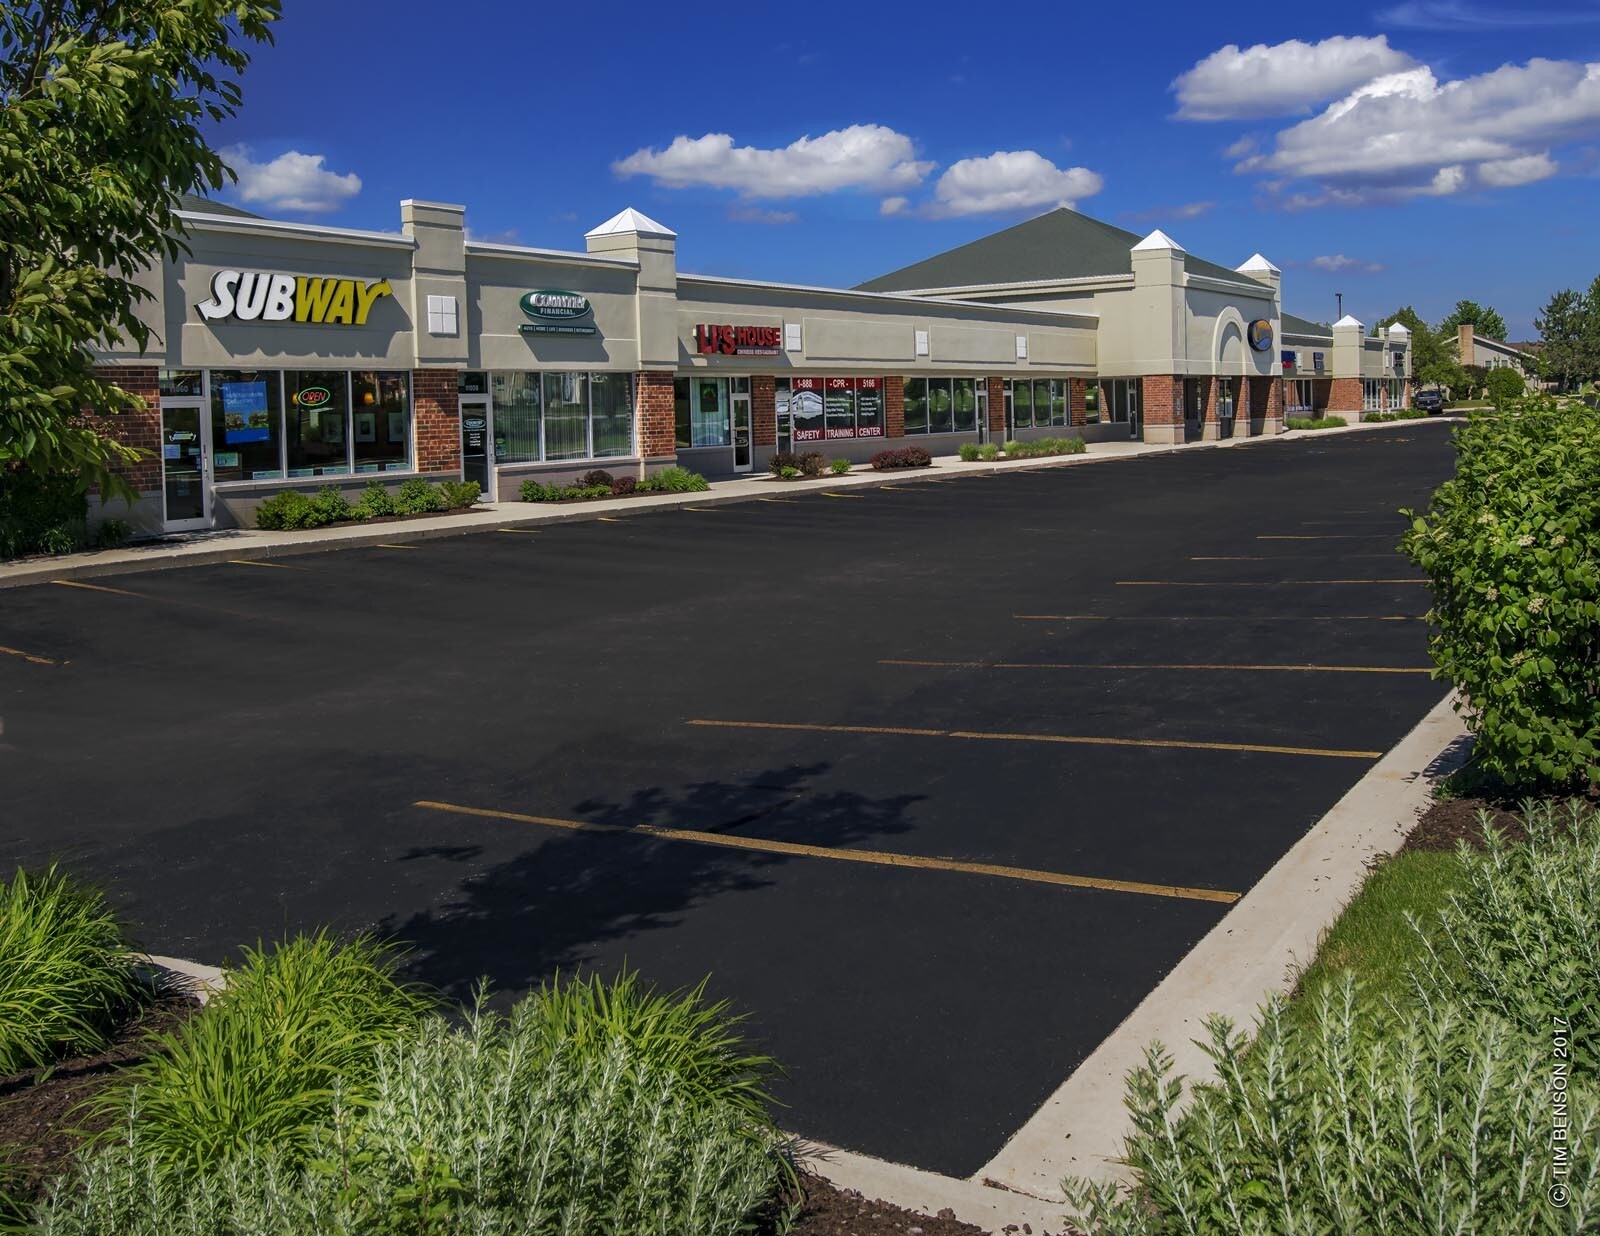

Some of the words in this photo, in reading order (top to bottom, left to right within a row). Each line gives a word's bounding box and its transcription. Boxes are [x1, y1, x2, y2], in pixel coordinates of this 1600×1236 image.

[195, 270, 392, 325] SUBWAY
[737, 326, 781, 346] HOUSE
[302, 391, 326, 401] OPEN
[796, 430, 820, 440] SAFETY
[826, 428, 854, 438] TRAINING
[858, 426, 881, 437] CENTER
